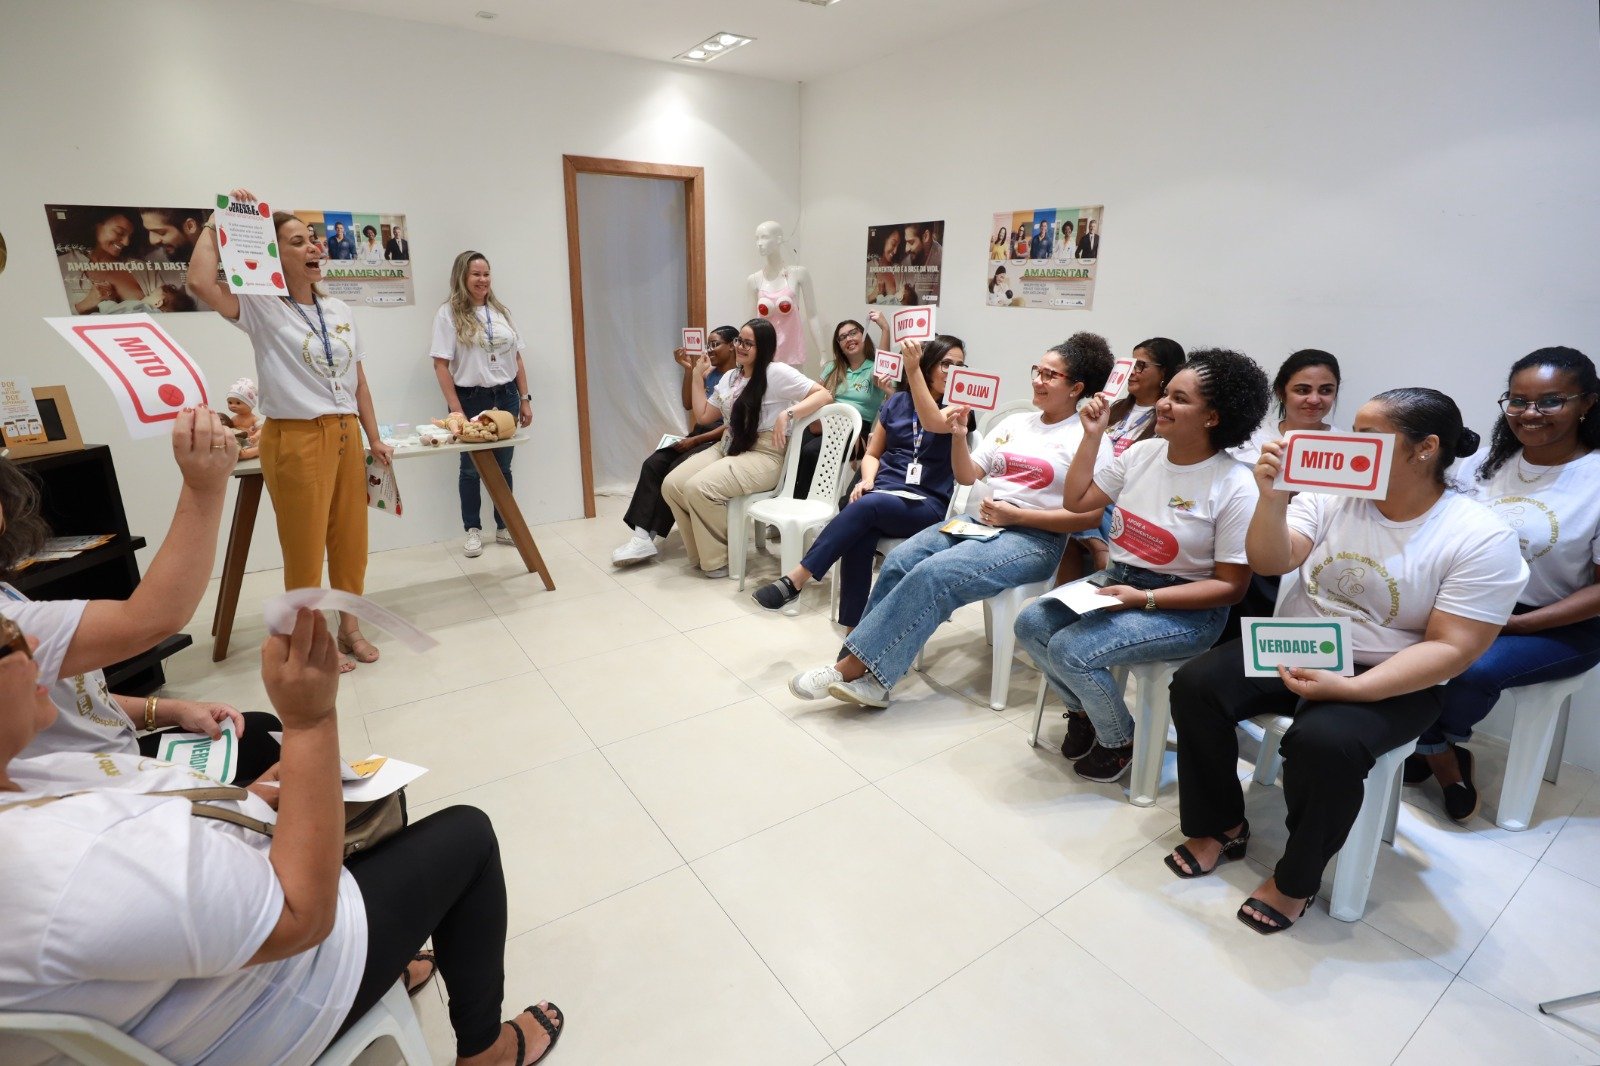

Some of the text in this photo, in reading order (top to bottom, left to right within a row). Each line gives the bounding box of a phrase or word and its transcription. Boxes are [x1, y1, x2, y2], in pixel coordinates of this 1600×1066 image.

[67, 261, 187, 273] AMAMENTAÇÃO É A BASE
[326, 269, 404, 278] AMAMENTAR
[1024, 268, 1090, 278] AMAMENTAR
[898, 318, 914, 331] MITO
[113, 336, 172, 378] MITO
[966, 383, 990, 398] MITO
[1300, 450, 1344, 471] MITO
[1259, 639, 1318, 654] VERDADE
[90, 713, 119, 727] Hospital
